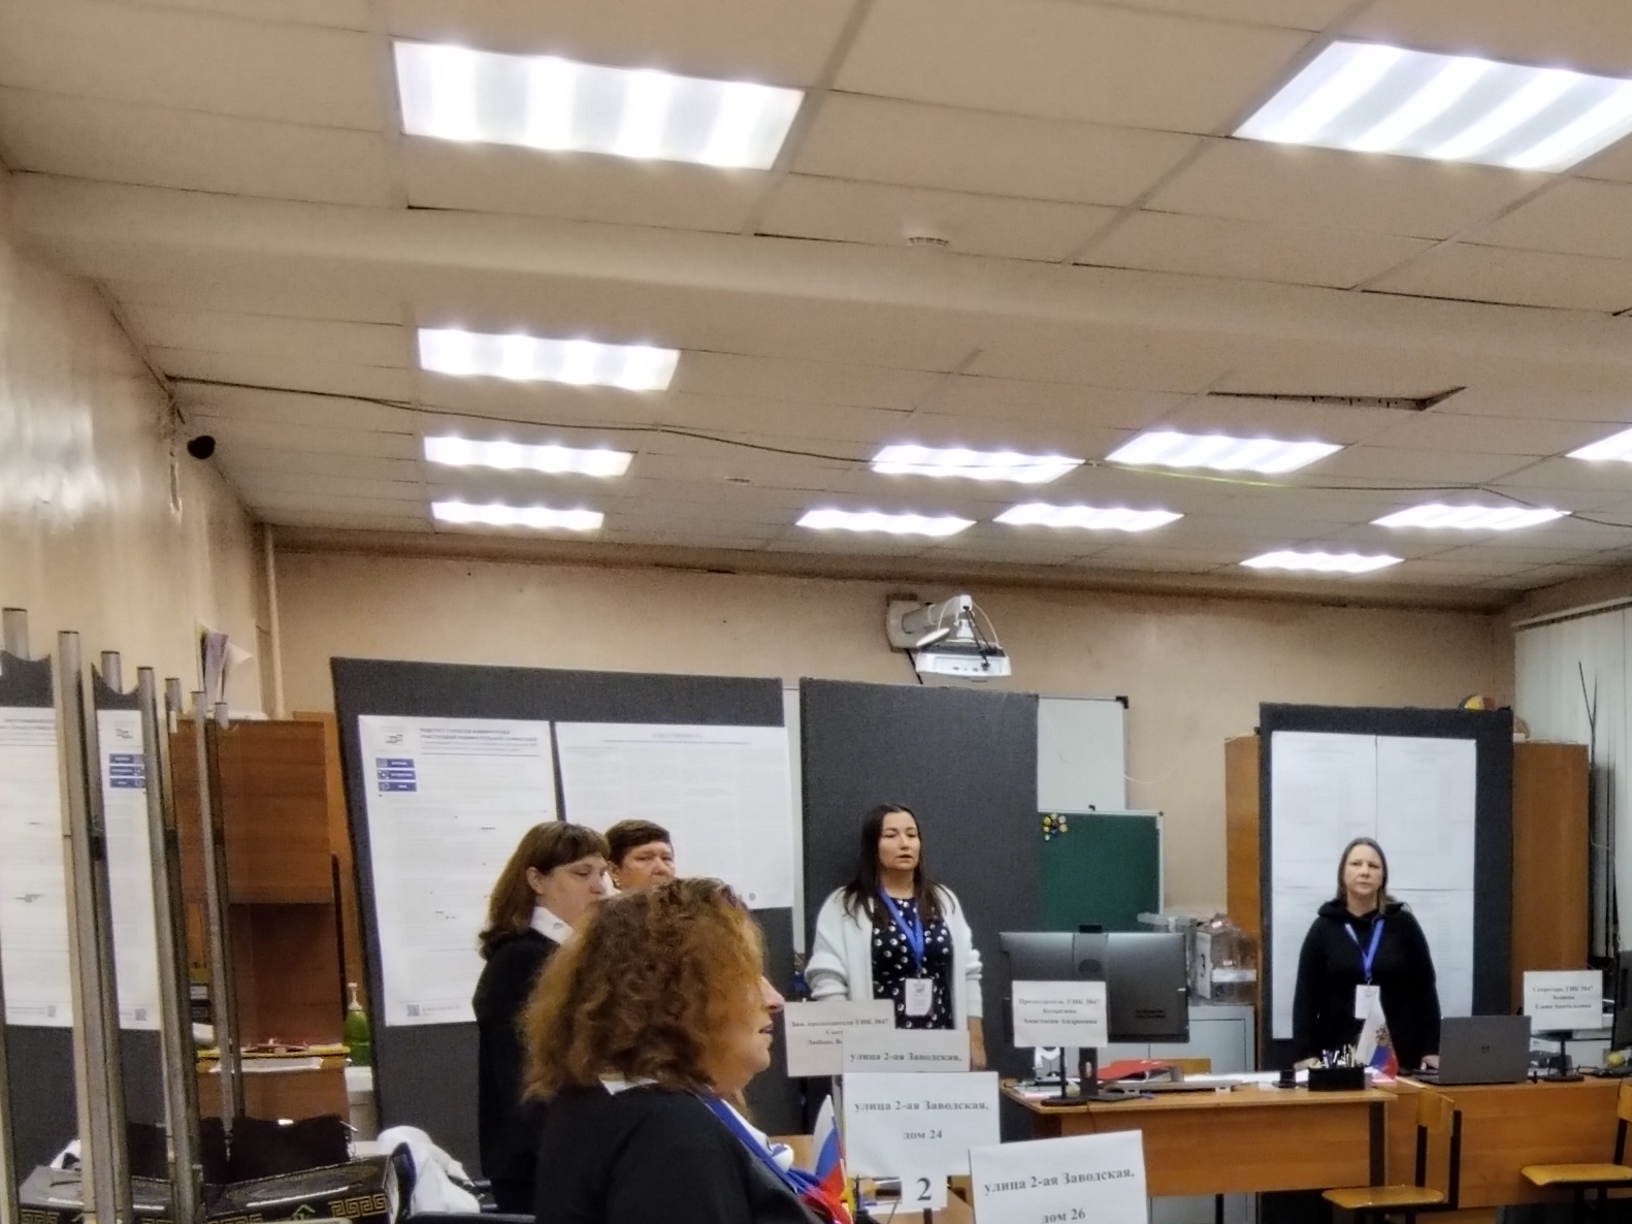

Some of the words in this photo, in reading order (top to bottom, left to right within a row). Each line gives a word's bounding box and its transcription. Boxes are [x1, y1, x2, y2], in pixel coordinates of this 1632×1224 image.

[850, 1053, 881, 1062] улица
[884, 1052, 905, 1061] 2-ая
[908, 1052, 962, 1062] Заводская,
[854, 1101, 892, 1113] улица
[895, 1100, 920, 1111] 2-ая
[924, 1100, 990, 1111] Заводская,
[903, 1131, 926, 1140] дом
[929, 1129, 943, 1139] 24
[916, 1177, 933, 1201] 2
[983, 1180, 1026, 1196] улица
[1030, 1175, 1059, 1188] 2-ая
[1063, 1168, 1136, 1185] Заводская,
[1041, 1211, 1067, 1224] дом
[1070, 1208, 1087, 1221] 26
